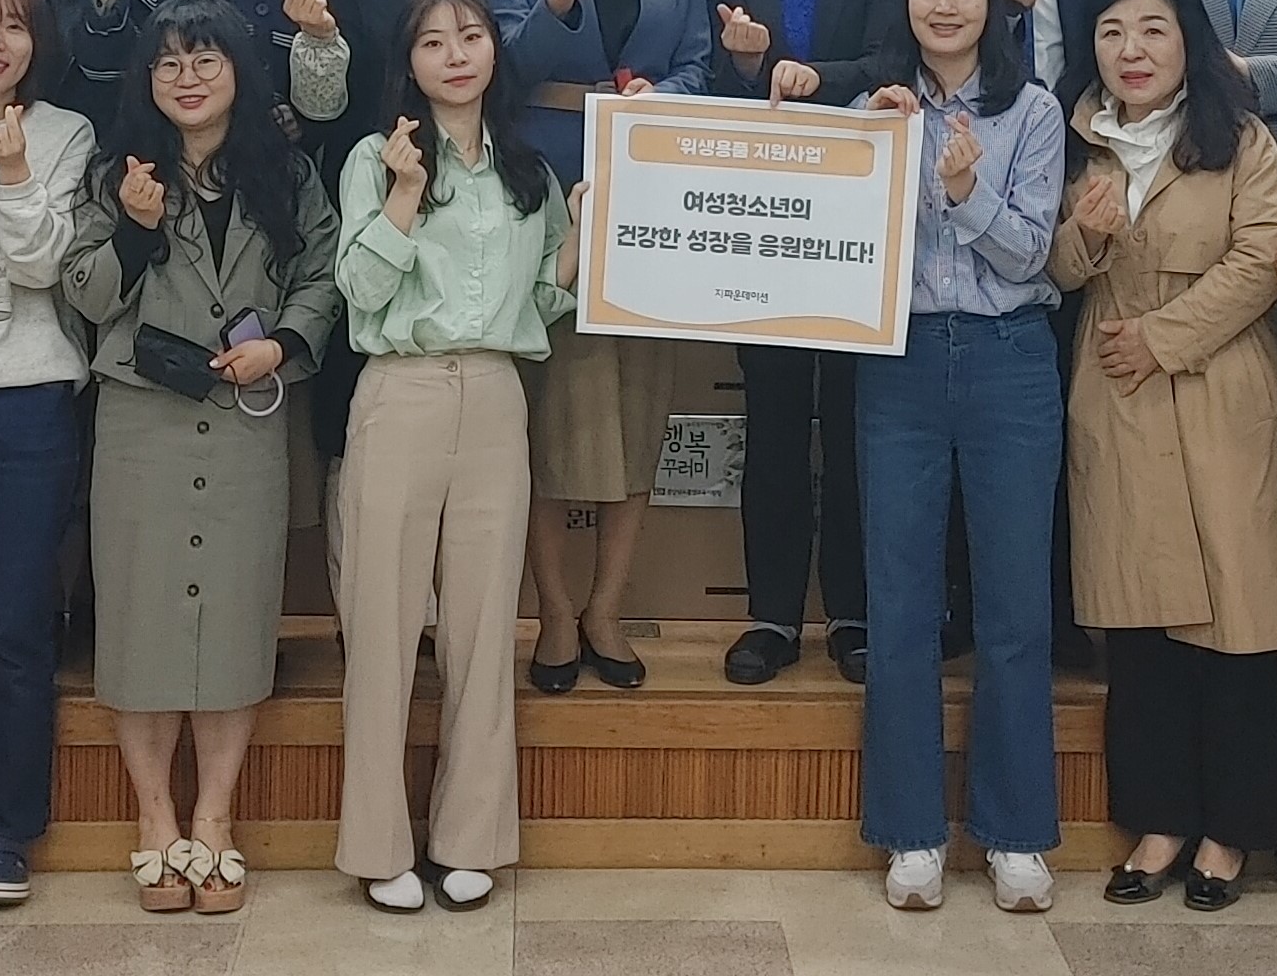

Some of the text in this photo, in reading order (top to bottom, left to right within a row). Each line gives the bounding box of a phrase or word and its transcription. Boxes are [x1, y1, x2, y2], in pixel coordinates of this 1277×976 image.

[683, 190, 811, 221] 여성청소년의
[616, 225, 875, 264] 건강한 성장을 응원합니다!
[714, 288, 769, 304] 지파운데이션
[661, 458, 709, 479] 꾸러미
